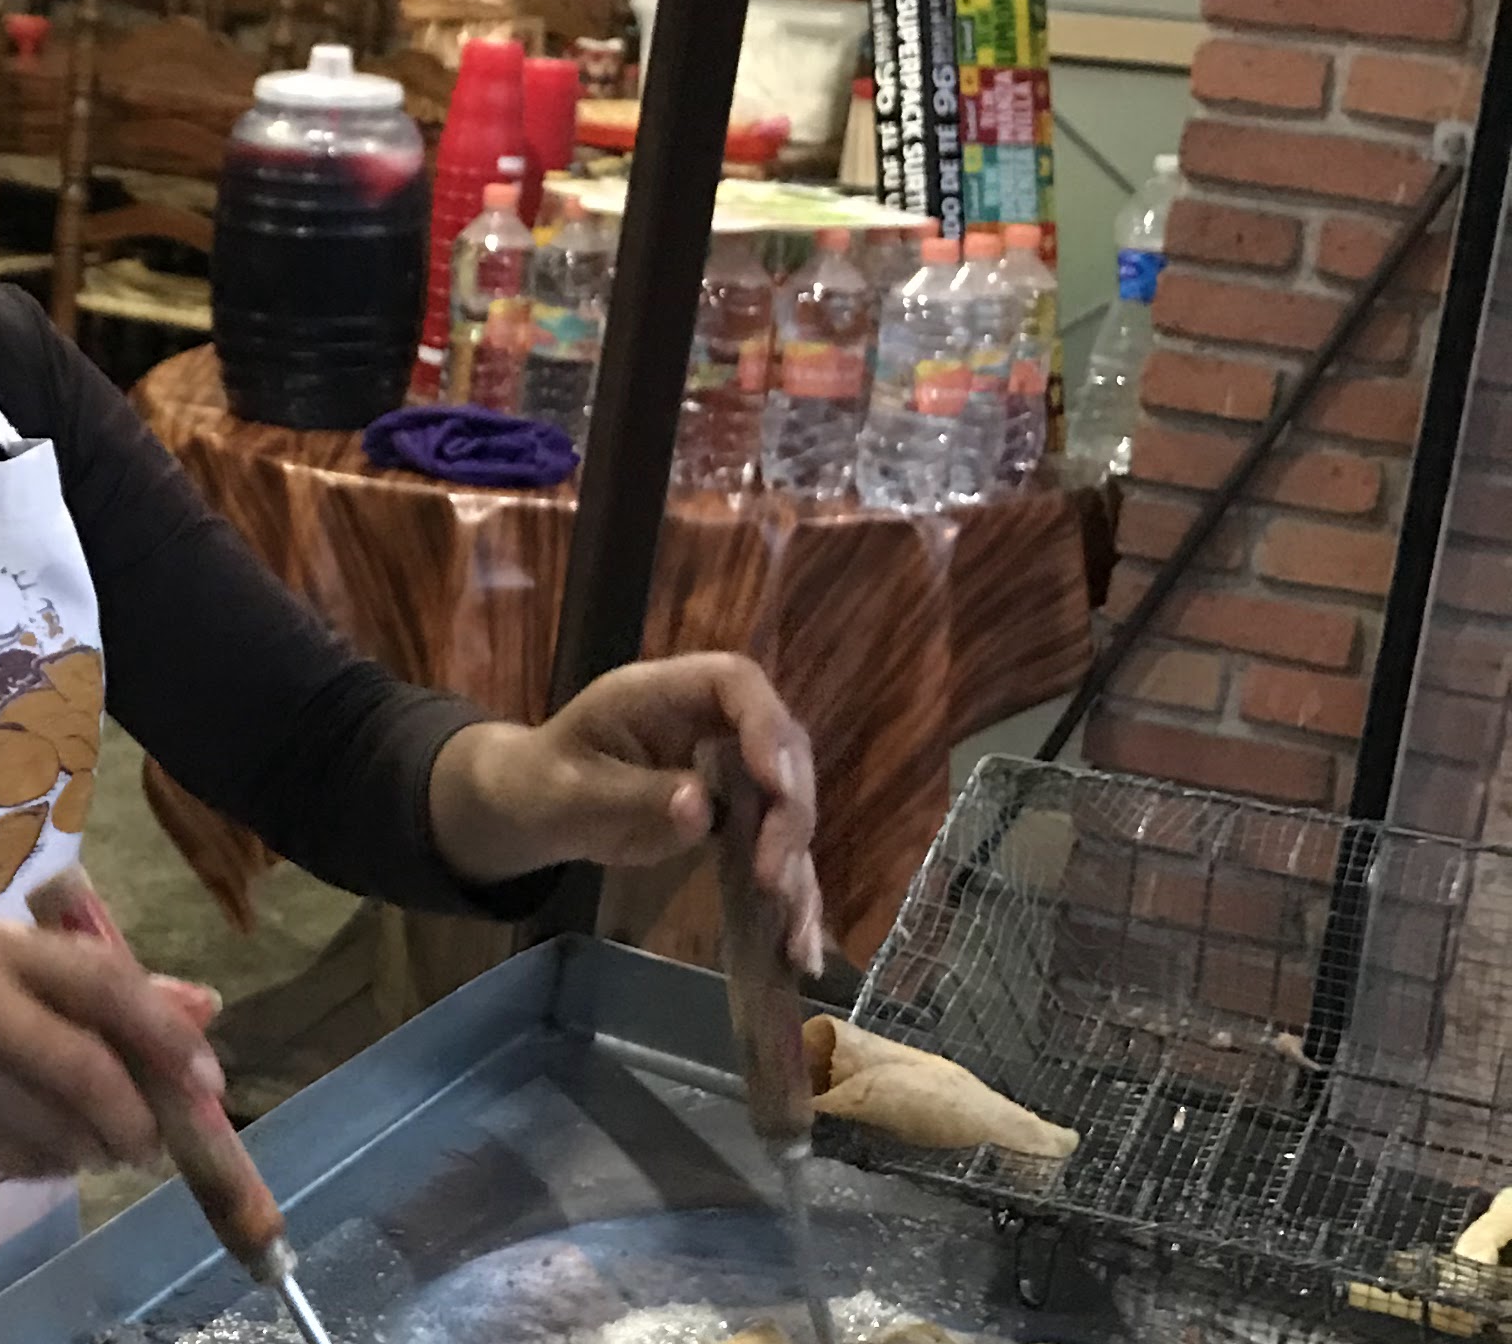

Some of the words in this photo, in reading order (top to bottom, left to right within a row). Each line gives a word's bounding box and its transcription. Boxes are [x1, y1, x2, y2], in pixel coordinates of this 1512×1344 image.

[932, 64, 957, 116] 96
[902, 142, 926, 213] SURTI
[939, 159, 959, 193] DE
